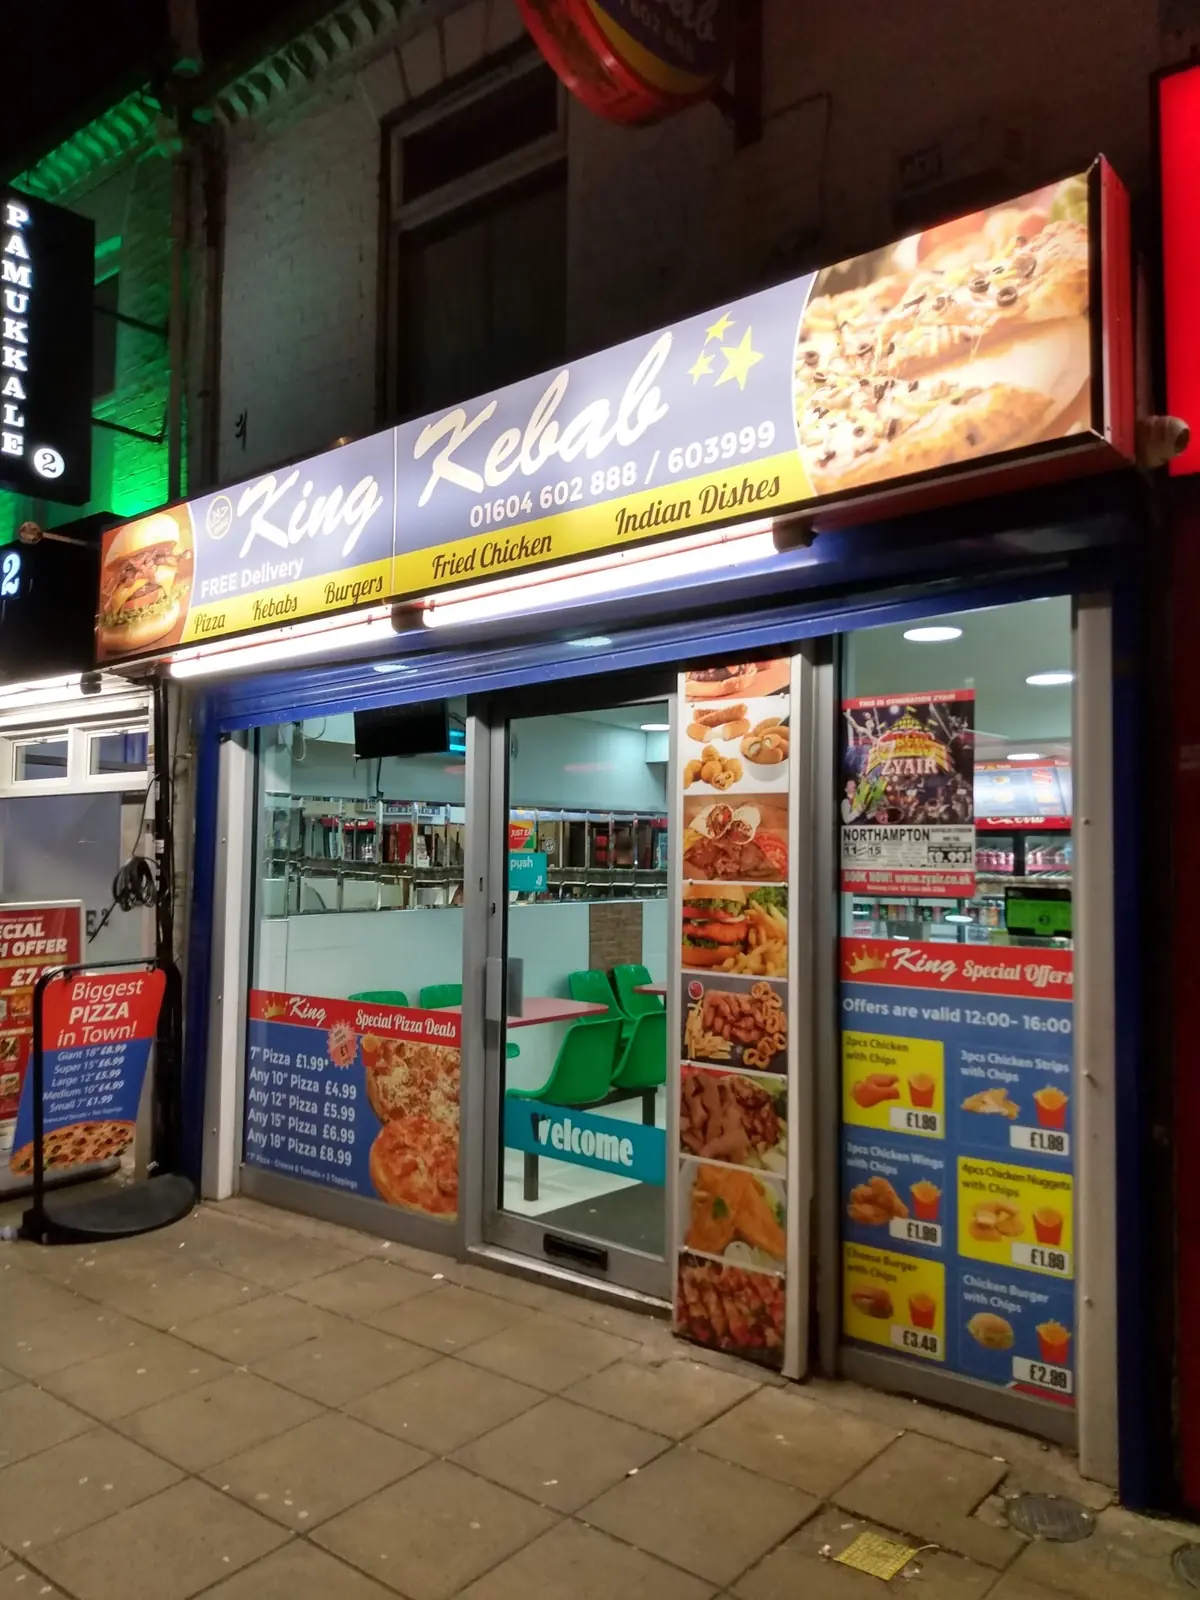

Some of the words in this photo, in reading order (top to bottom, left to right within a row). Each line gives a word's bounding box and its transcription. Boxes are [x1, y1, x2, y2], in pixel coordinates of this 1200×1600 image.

[1, 205, 33, 457] PAMUKKALE
[237, 470, 383, 558] King
[414, 332, 673, 508] Kebab
[42, 454, 58, 474] 2
[469, 493, 533, 528] 01604
[540, 476, 583, 509] 602
[590, 461, 636, 495] 888
[644, 450, 660, 484] /
[668, 420, 775, 474] 603999
[194, 613, 226, 634] Pizza
[253, 593, 298, 621] Kebabs
[324, 575, 383, 604] Burgers
[432, 549, 476, 580] Fried
[480, 534, 552, 569] Chicken
[615, 497, 691, 536] Indian
[699, 475, 781, 515] Dishes
[1, 552, 21, 598] 2
[201, 573, 237, 598] FREE
[241, 558, 303, 588] Delivery
[881, 758, 939, 775] ZYAIR
[844, 828, 930, 842] NORTHAMPTON
[511, 856, 533, 871] push
[0, 922, 45, 939] CIAL
[12, 939, 67, 956] OFFER
[891, 947, 958, 983] King
[962, 960, 1021, 983] Special
[1024, 963, 1074, 988] Offers
[72, 979, 144, 1004] Biggest
[69, 1002, 129, 1025] PIZZA
[289, 997, 327, 1027] King
[356, 1008, 392, 1030] Special
[394, 1014, 423, 1034] Pizza
[425, 1018, 456, 1038] Deals
[843, 998, 889, 1017] Offers
[892, 1005, 918, 1018] are
[922, 1005, 961, 1023] valid
[1023, 1015, 1072, 1034] 16:00
[57, 1027, 76, 1048] in
[81, 1020, 138, 1043] Town!
[58, 1050, 82, 1061] Giant
[870, 1039, 909, 1052] Chicken
[263, 1048, 291, 1066] Pizza
[869, 1053, 896, 1066] Chips
[987, 1053, 1033, 1068] Chicken
[1035, 1058, 1070, 1074] Strips
[54, 1064, 81, 1075] Super
[960, 1066, 985, 1078] with
[987, 1068, 1019, 1083] Chips
[52, 1077, 78, 1088] Large
[250, 1067, 269, 1087] Any
[273, 1070, 288, 1085] 10"
[291, 1075, 319, 1093] Pizza
[325, 1080, 357, 1100] £4.99
[42, 1088, 81, 1101] Medium
[249, 1087, 269, 1106] Any
[272, 1091, 287, 1106] 12"
[289, 1096, 318, 1114] Pizza
[323, 1101, 355, 1122] £5.99
[49, 1102, 76, 1113] Small
[248, 1107, 268, 1126] Any
[271, 1111, 286, 1126] 15"
[288, 1117, 317, 1136] Pizza
[323, 1123, 355, 1144] £6.99
[247, 1128, 267, 1148] Any
[270, 1132, 286, 1148] 18"
[288, 1138, 316, 1158] Pizza
[320, 1145, 352, 1166] £8.99
[870, 1146, 911, 1162] Chicken
[911, 1152, 944, 1170] Wings
[870, 1160, 898, 1176] Chips
[986, 1167, 1025, 1182] Chicken
[1027, 1174, 1071, 1191] Nuggets
[988, 1183, 1019, 1198] Chips
[883, 1256, 918, 1273] Burger
[962, 1274, 1007, 1294] Chicken
[1009, 1285, 1049, 1303] Burger
[963, 1291, 988, 1305] with
[990, 1296, 1021, 1313] Chips
